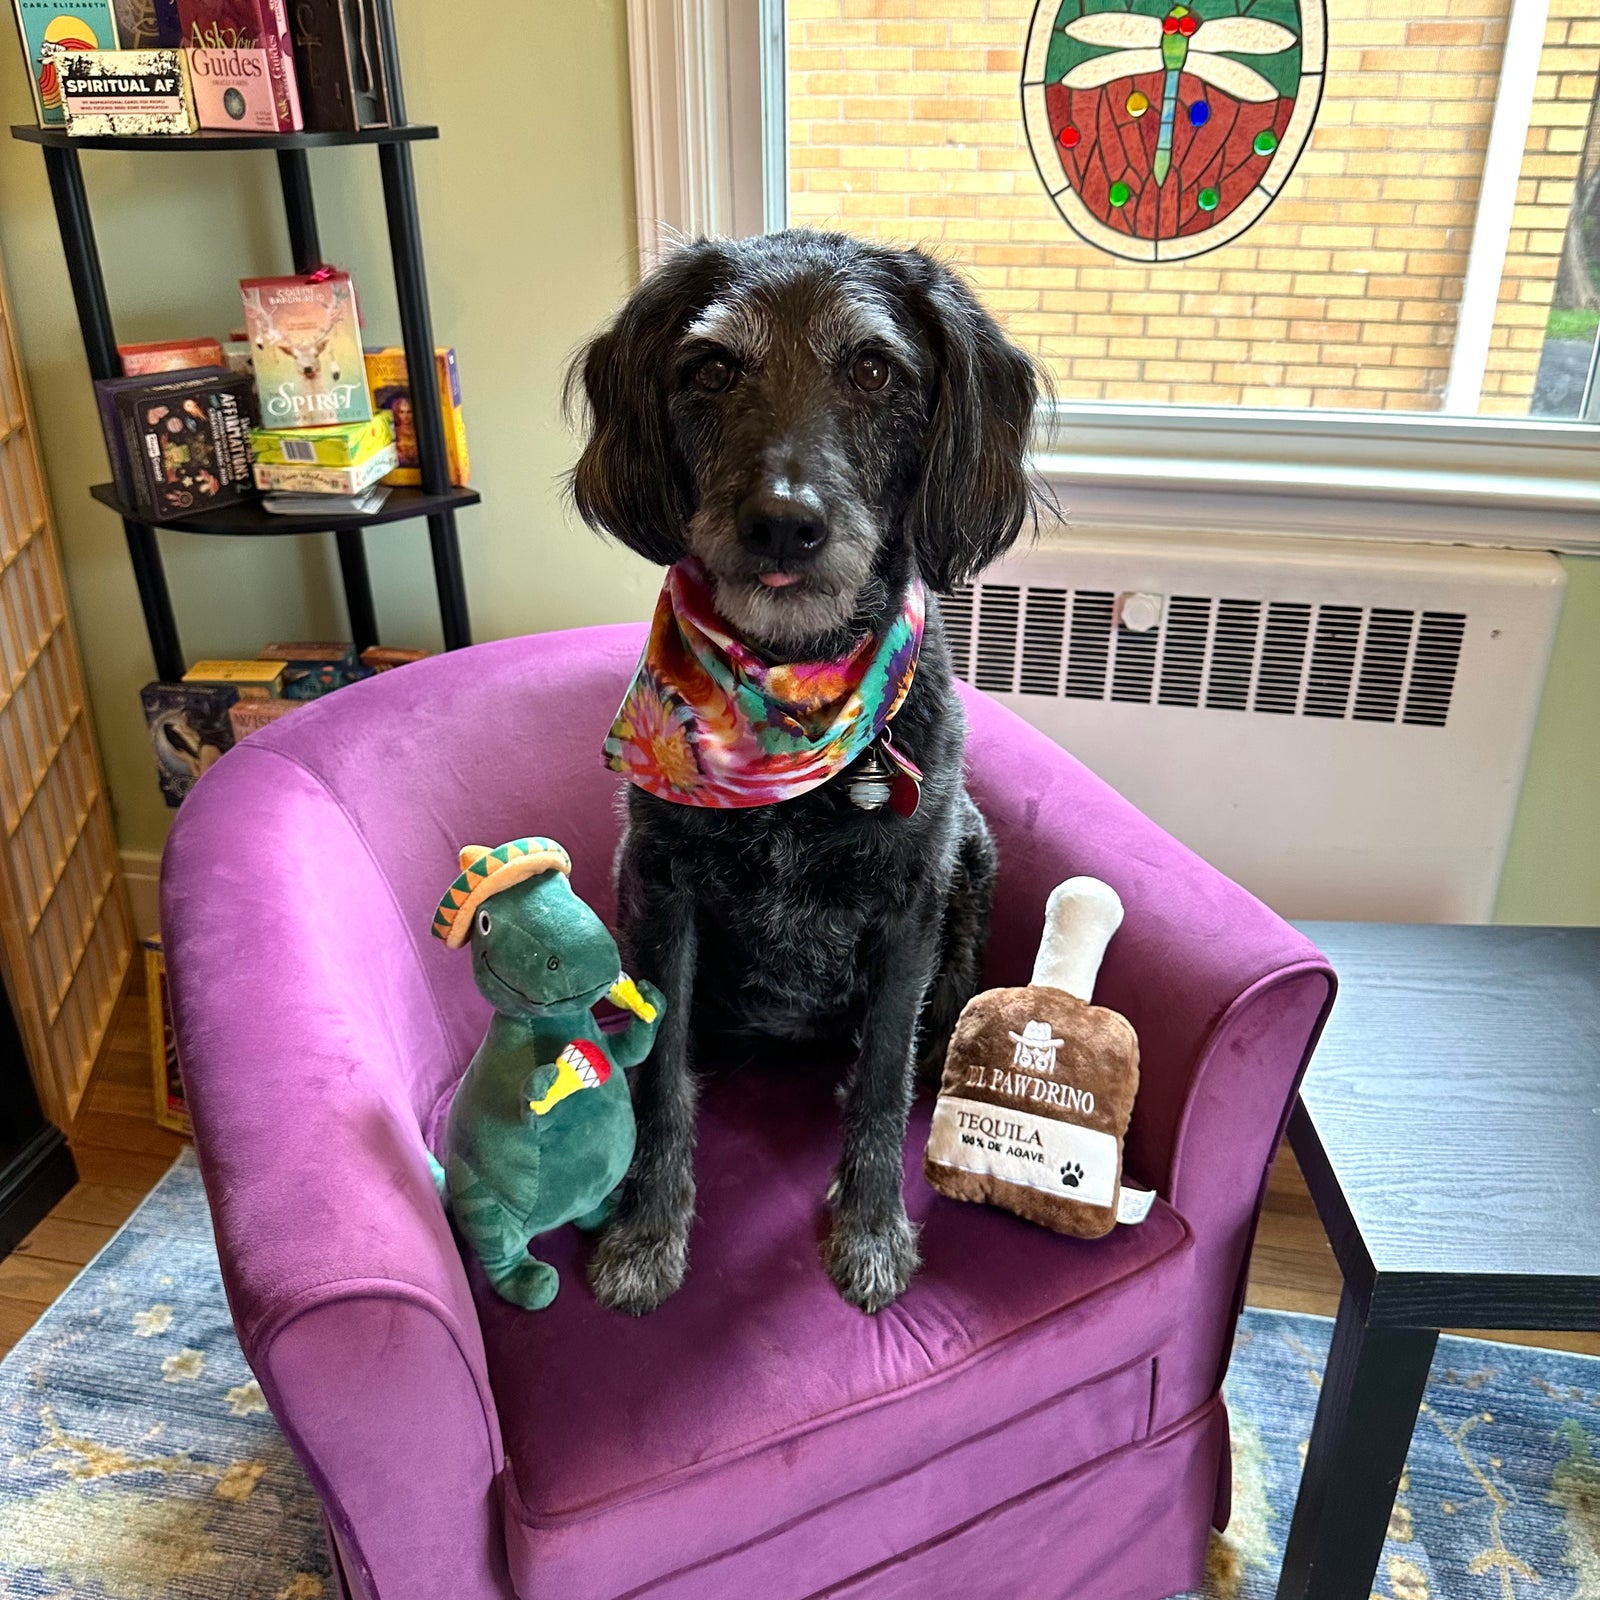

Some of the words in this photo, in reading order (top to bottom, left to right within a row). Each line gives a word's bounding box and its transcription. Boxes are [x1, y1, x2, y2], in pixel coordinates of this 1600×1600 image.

[190, 20, 226, 49] Ask
[191, 48, 262, 78] Guides
[66, 79, 150, 93] SPIRITUAL
[154, 78, 175, 93] AF
[219, 393, 250, 482] AFFIRMATIONS
[966, 1065, 988, 1087] EL
[957, 1110, 1043, 1148] TEQUILA
[1006, 1143, 1045, 1163] AGAVE
